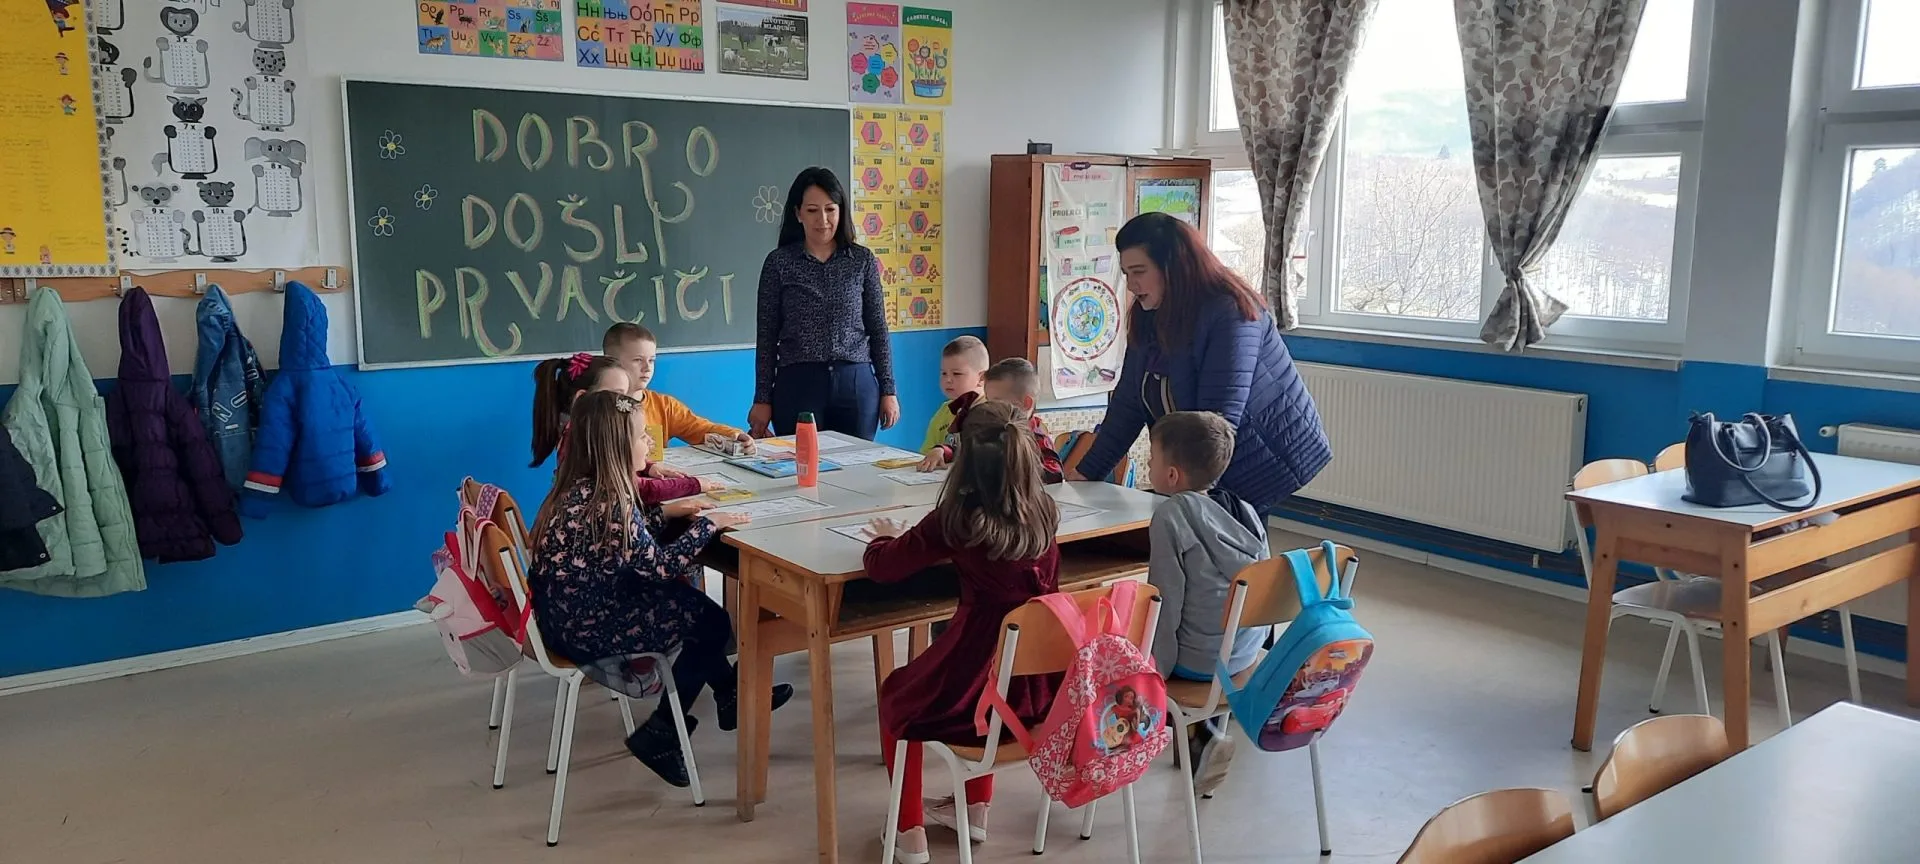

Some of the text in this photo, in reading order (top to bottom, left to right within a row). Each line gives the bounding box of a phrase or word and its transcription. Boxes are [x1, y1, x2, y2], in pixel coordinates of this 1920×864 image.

[420, 3, 437, 14] Oo
[450, 6, 465, 16] Pp
[479, 7, 491, 17] Rr
[508, 9, 521, 20] Ss
[451, 30, 466, 41] Uu
[481, 32, 495, 42] Vv
[510, 34, 522, 45] Zz
[869, 124, 876, 142] 1
[915, 126, 924, 143] 2
[472, 108, 720, 224] DOBRO
[868, 170, 877, 188] 3
[915, 169, 924, 188] 4
[462, 192, 668, 268] DOŠLI
[868, 216, 877, 233] 5
[914, 214, 924, 231] 6
